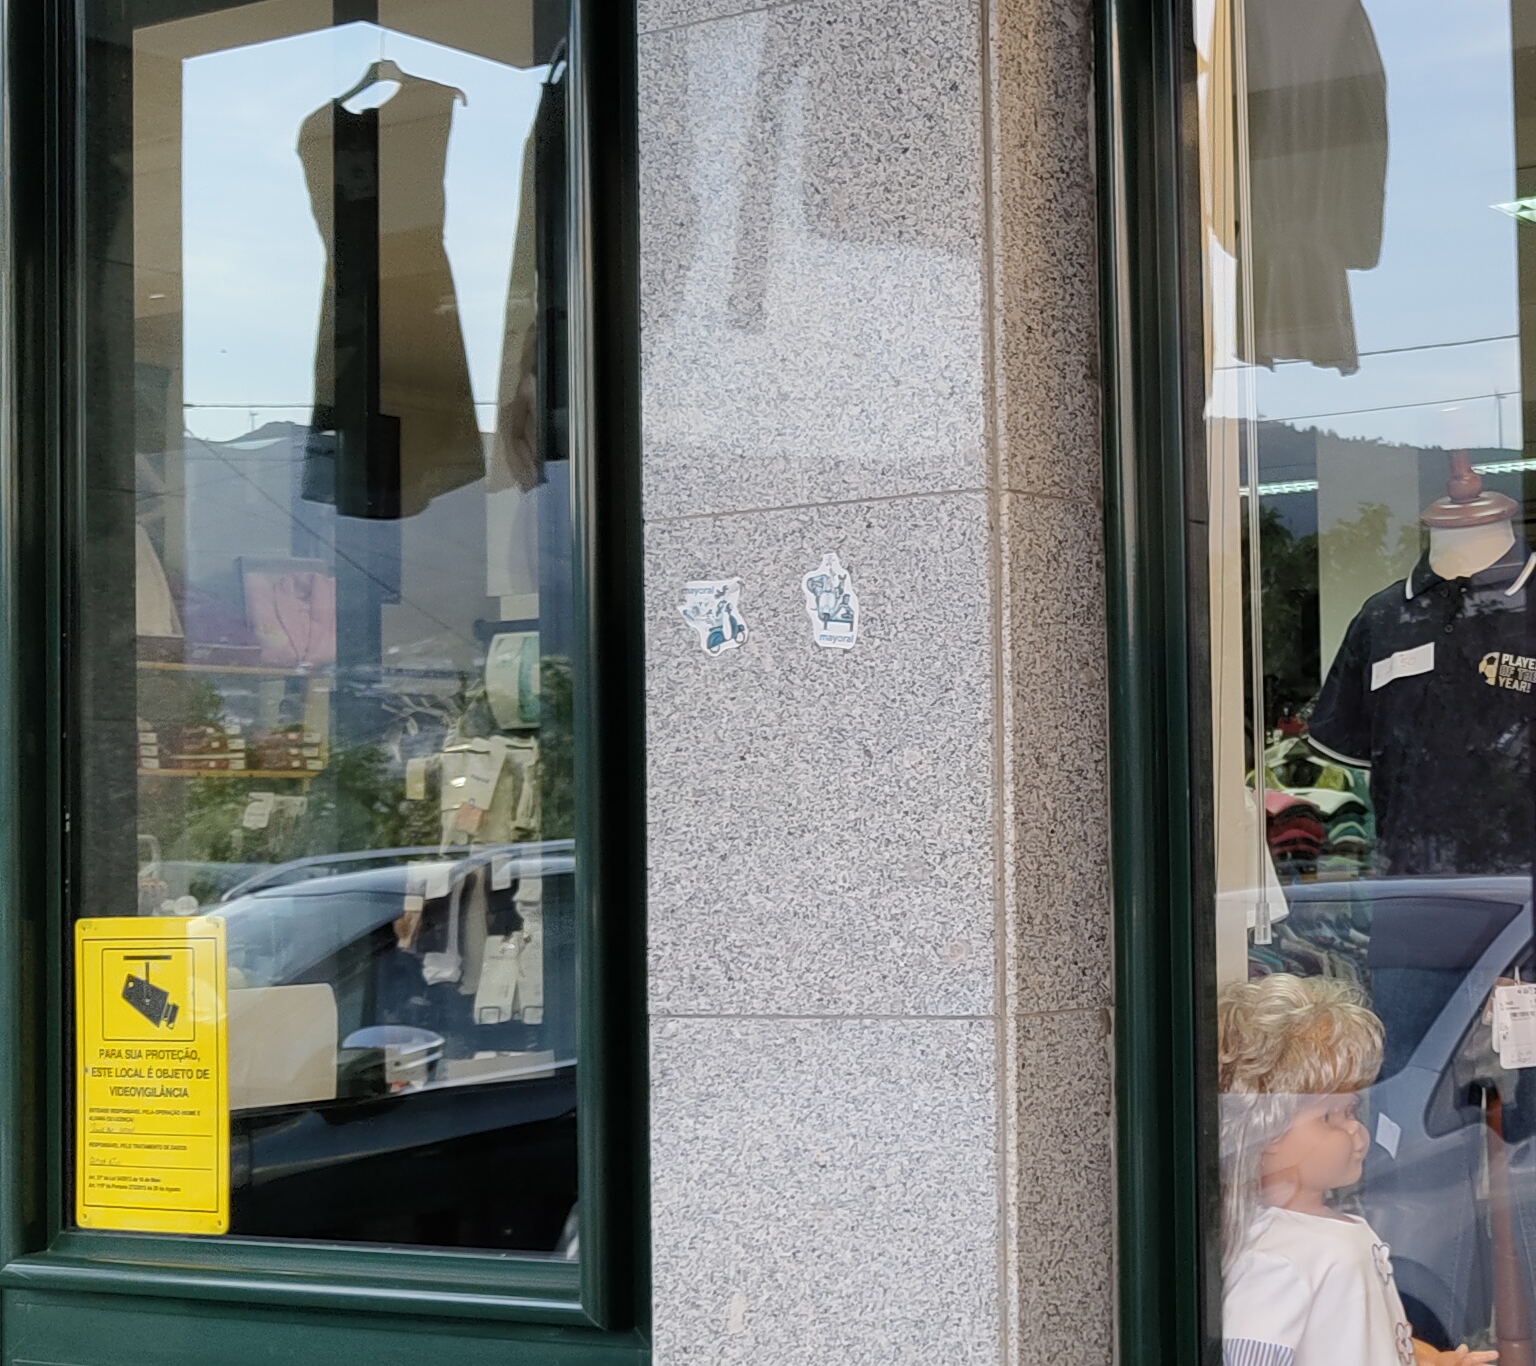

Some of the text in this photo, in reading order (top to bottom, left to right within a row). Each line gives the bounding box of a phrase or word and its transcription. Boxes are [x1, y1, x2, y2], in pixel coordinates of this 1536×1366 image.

[819, 634, 854, 644] mayoral
[1499, 676, 1531, 693] YEAR!
[98, 1047, 201, 1063] PARA SUA PROTEÇÃO,
[91, 1065, 210, 1080] ESTE LOCAL É OBJETO DE
[109, 1085, 190, 1098] VIDEOVIGILÂNCIA
